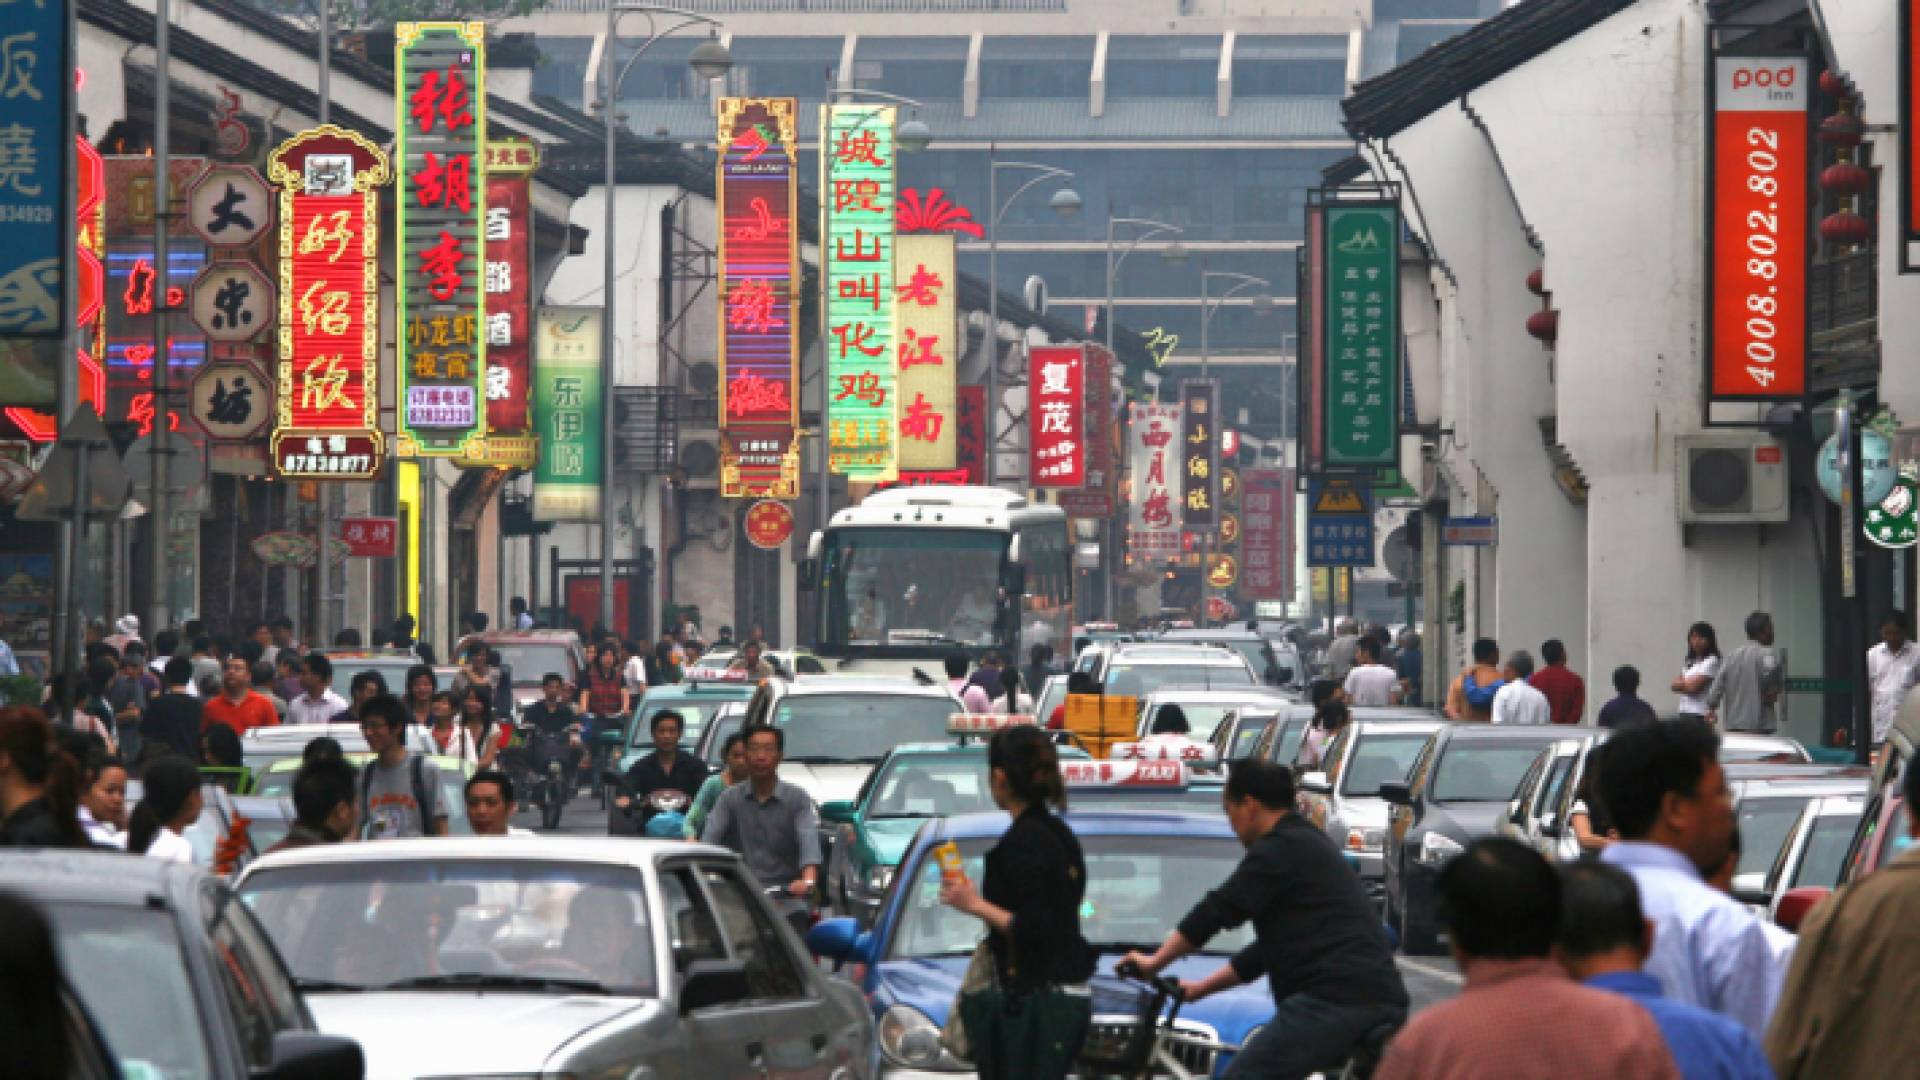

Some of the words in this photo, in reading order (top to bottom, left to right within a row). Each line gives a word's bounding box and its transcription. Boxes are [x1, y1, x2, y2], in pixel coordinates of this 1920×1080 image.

[1732, 66, 1795, 90] pod
[1767, 87, 1794, 100] inn
[831, 129, 885, 407] 城隍山叫化鸡
[1746, 126, 1778, 387] 4008.802.802
[407, 314, 475, 347] 小龙虾
[415, 351, 468, 379] 夜宵
[896, 263, 943, 443] 老江南
[1139, 765, 1176, 781] TAXI
